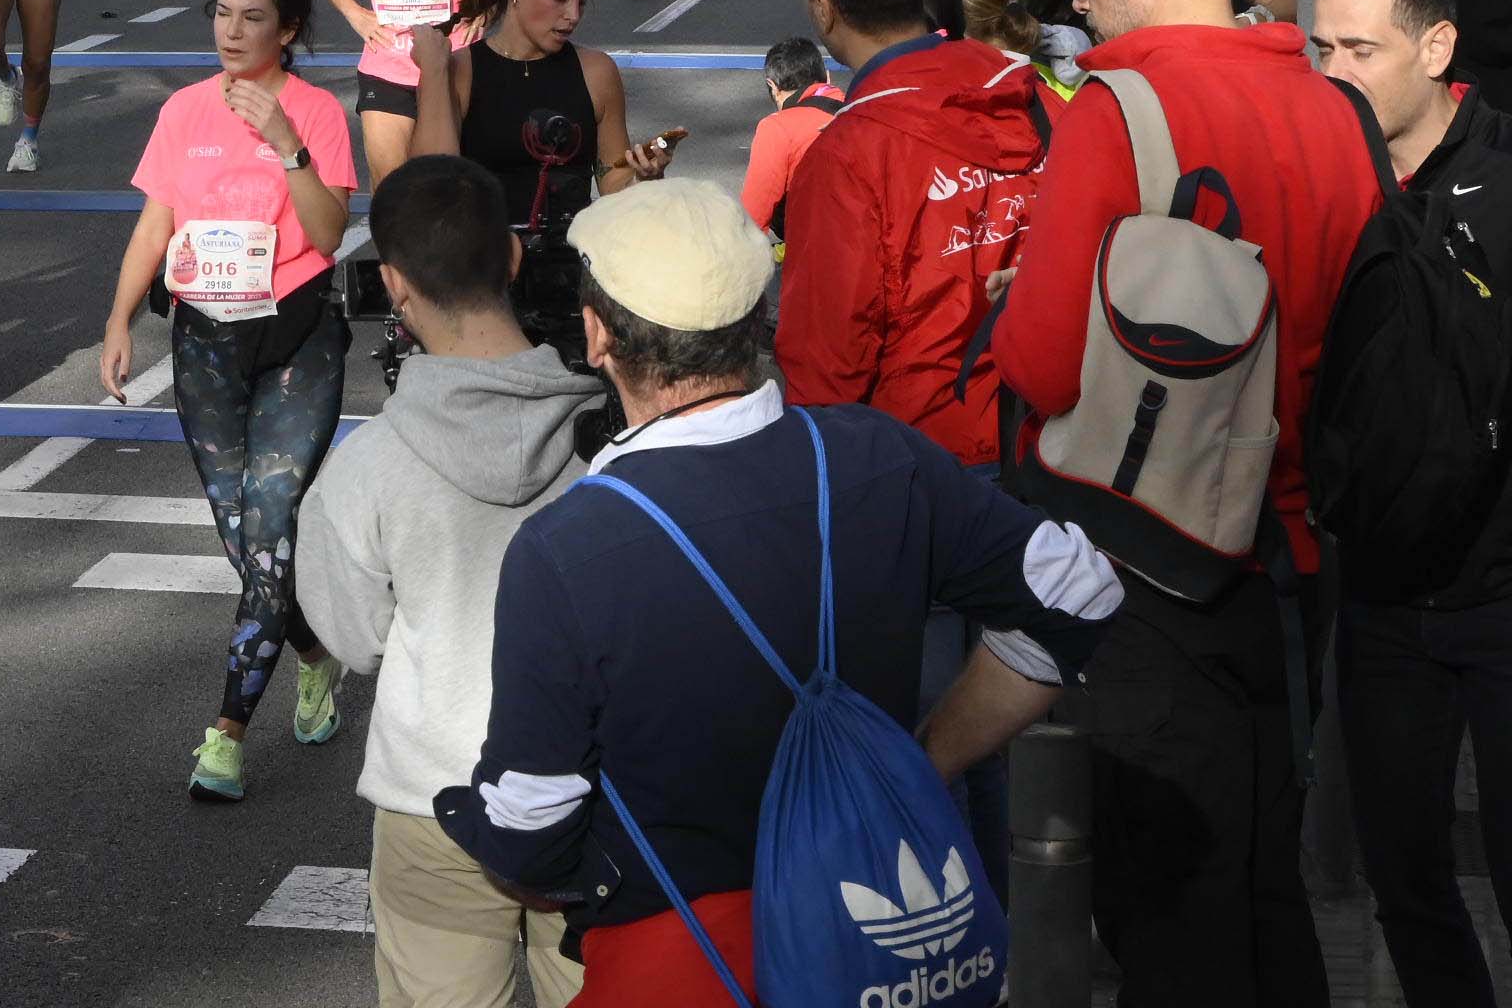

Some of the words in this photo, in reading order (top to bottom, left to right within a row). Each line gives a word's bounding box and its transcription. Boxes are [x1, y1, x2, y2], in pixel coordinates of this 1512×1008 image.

[200, 237, 241, 248] ASTURIANA
[202, 262, 237, 276] 016
[205, 281, 232, 290] 29188
[860, 945, 996, 1008] adidas
